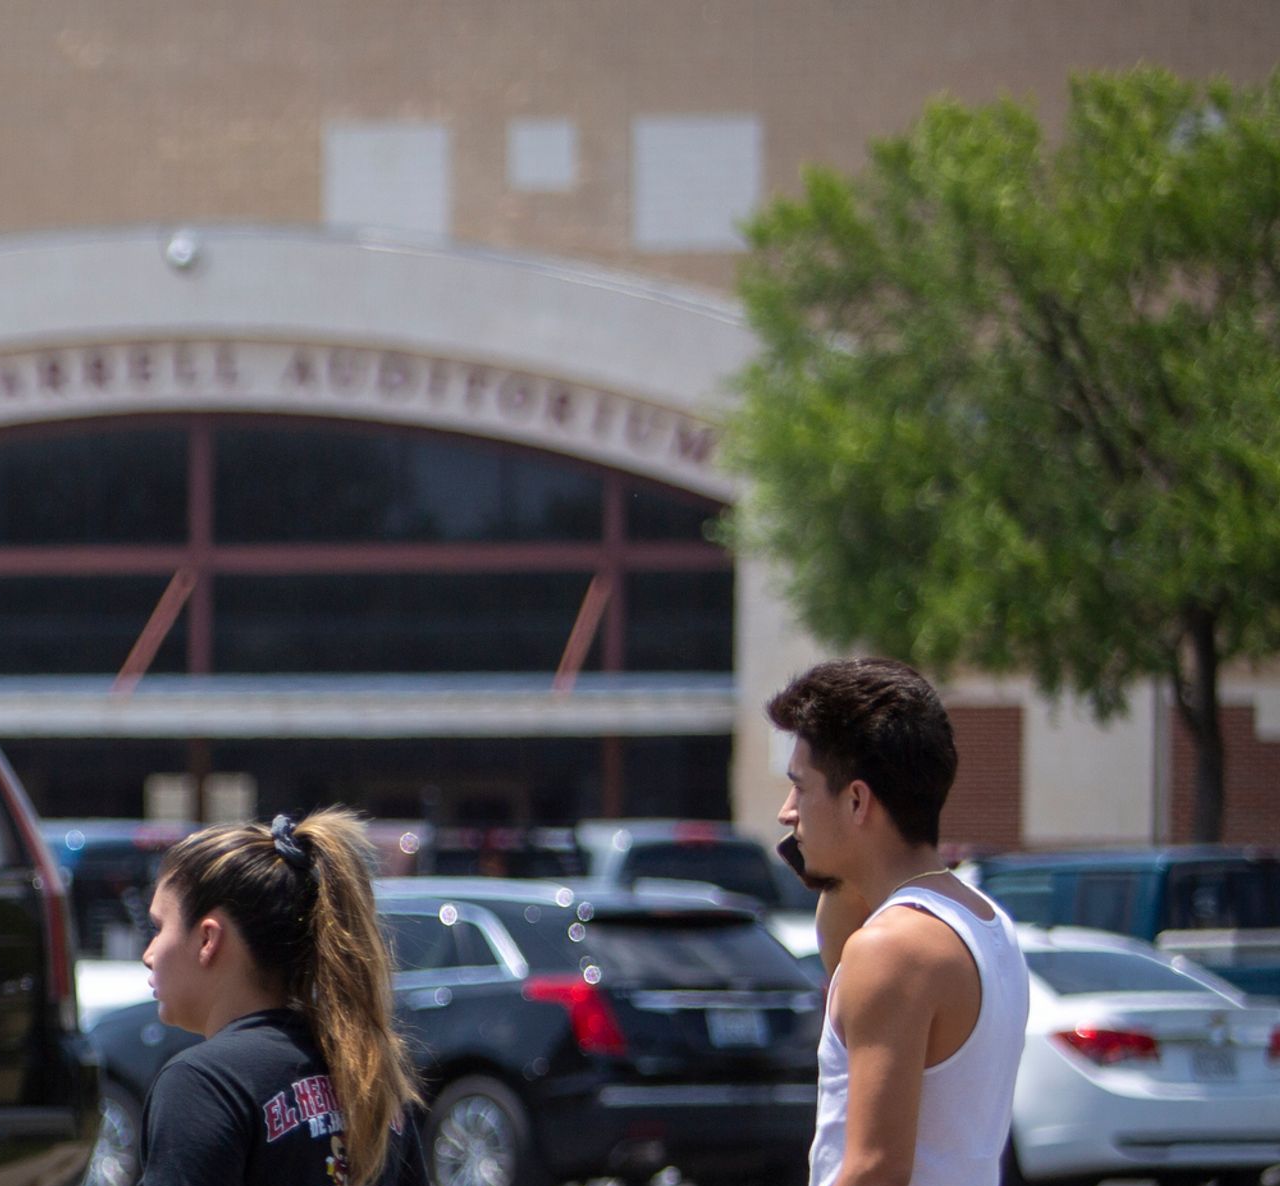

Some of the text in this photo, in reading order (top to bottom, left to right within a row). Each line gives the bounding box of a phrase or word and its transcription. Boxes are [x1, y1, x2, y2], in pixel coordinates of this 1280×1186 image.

[282, 347, 719, 464] AUDITORIUM
[263, 1091, 300, 1143] EL
[308, 1115, 328, 1138] DE
